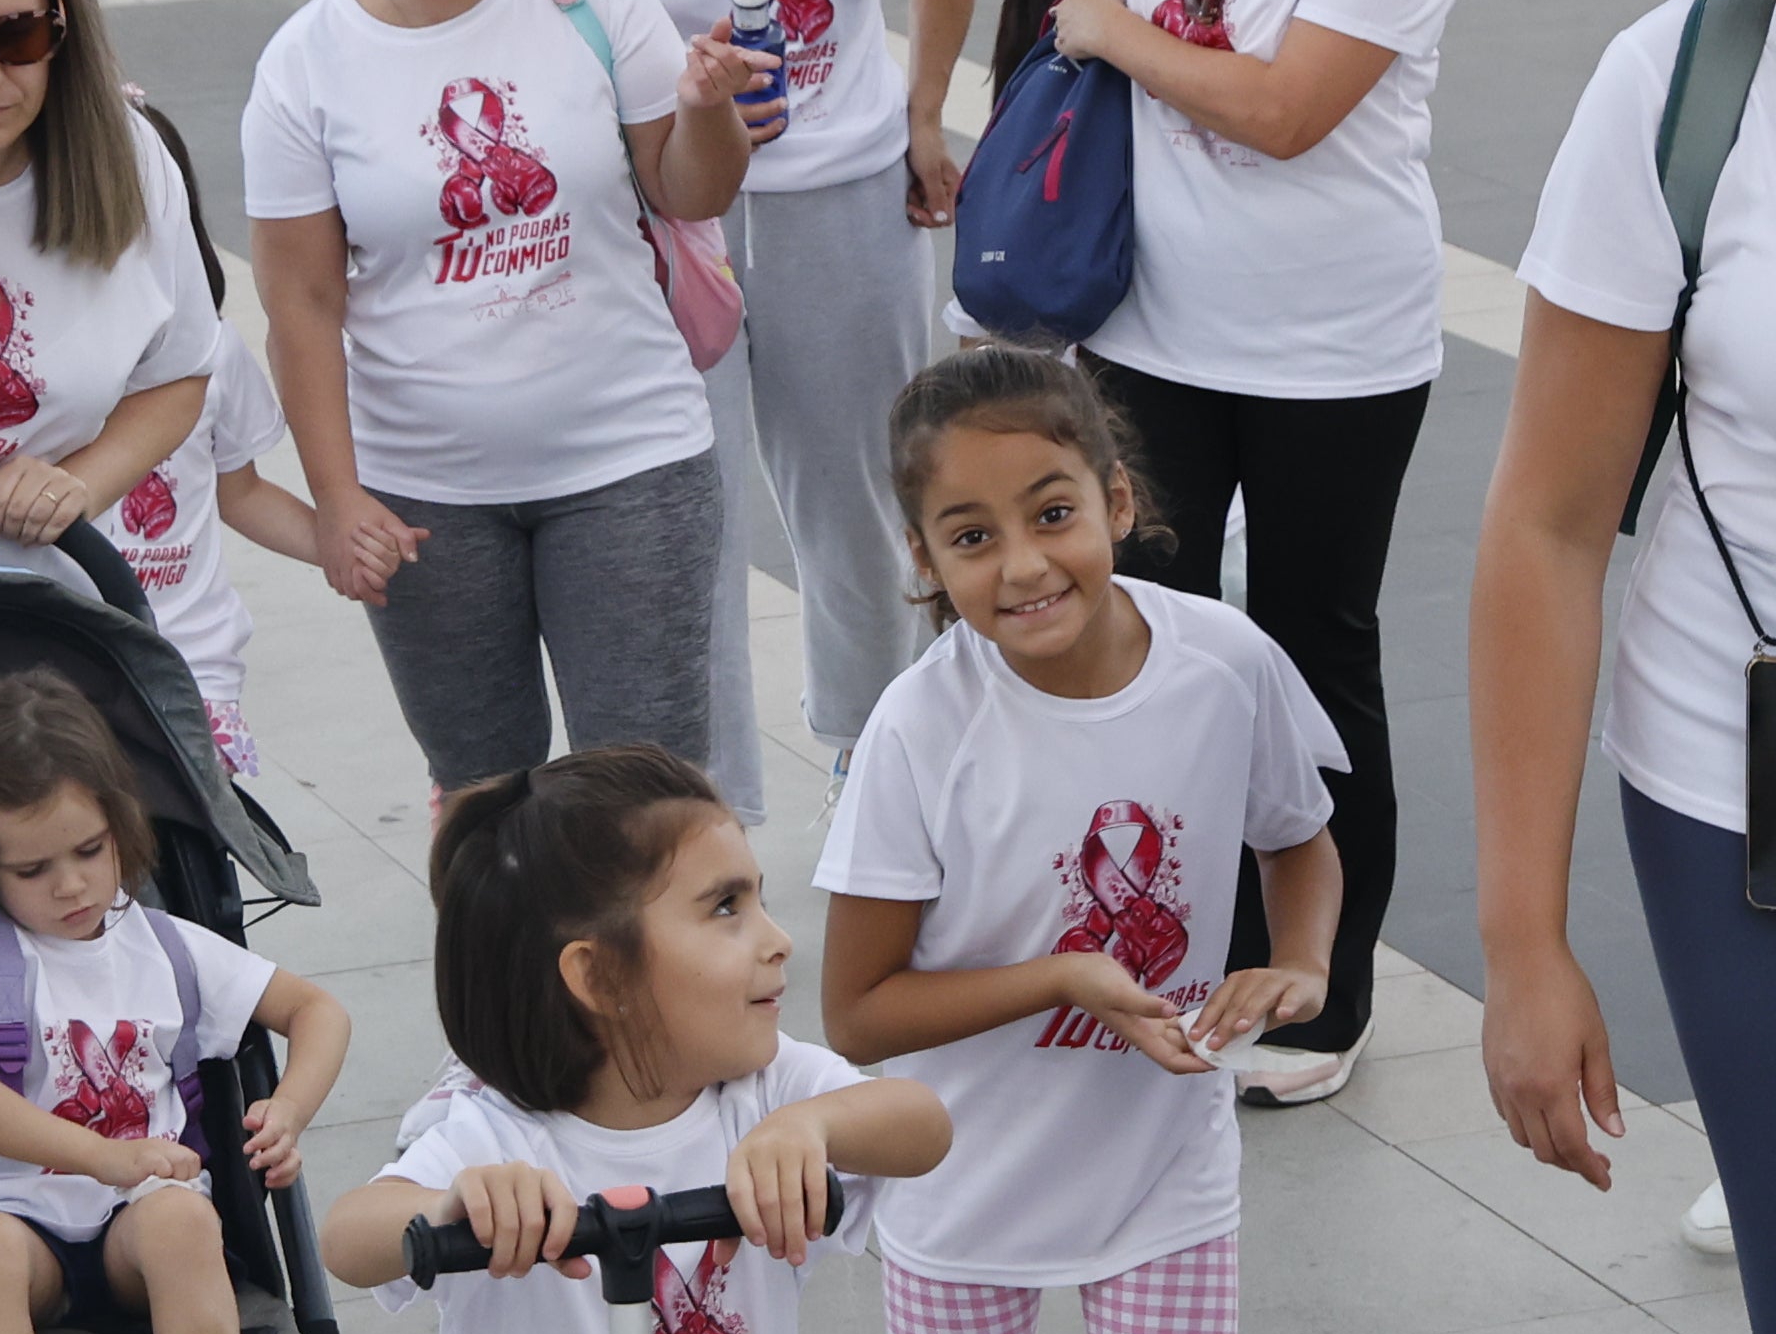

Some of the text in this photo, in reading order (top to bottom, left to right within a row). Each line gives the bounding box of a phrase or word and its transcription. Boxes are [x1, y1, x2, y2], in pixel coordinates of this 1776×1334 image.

[484, 228, 505, 251] NO
[433, 229, 571, 284] TÚ CONMIGO
[133, 563, 188, 592] NMIGO
